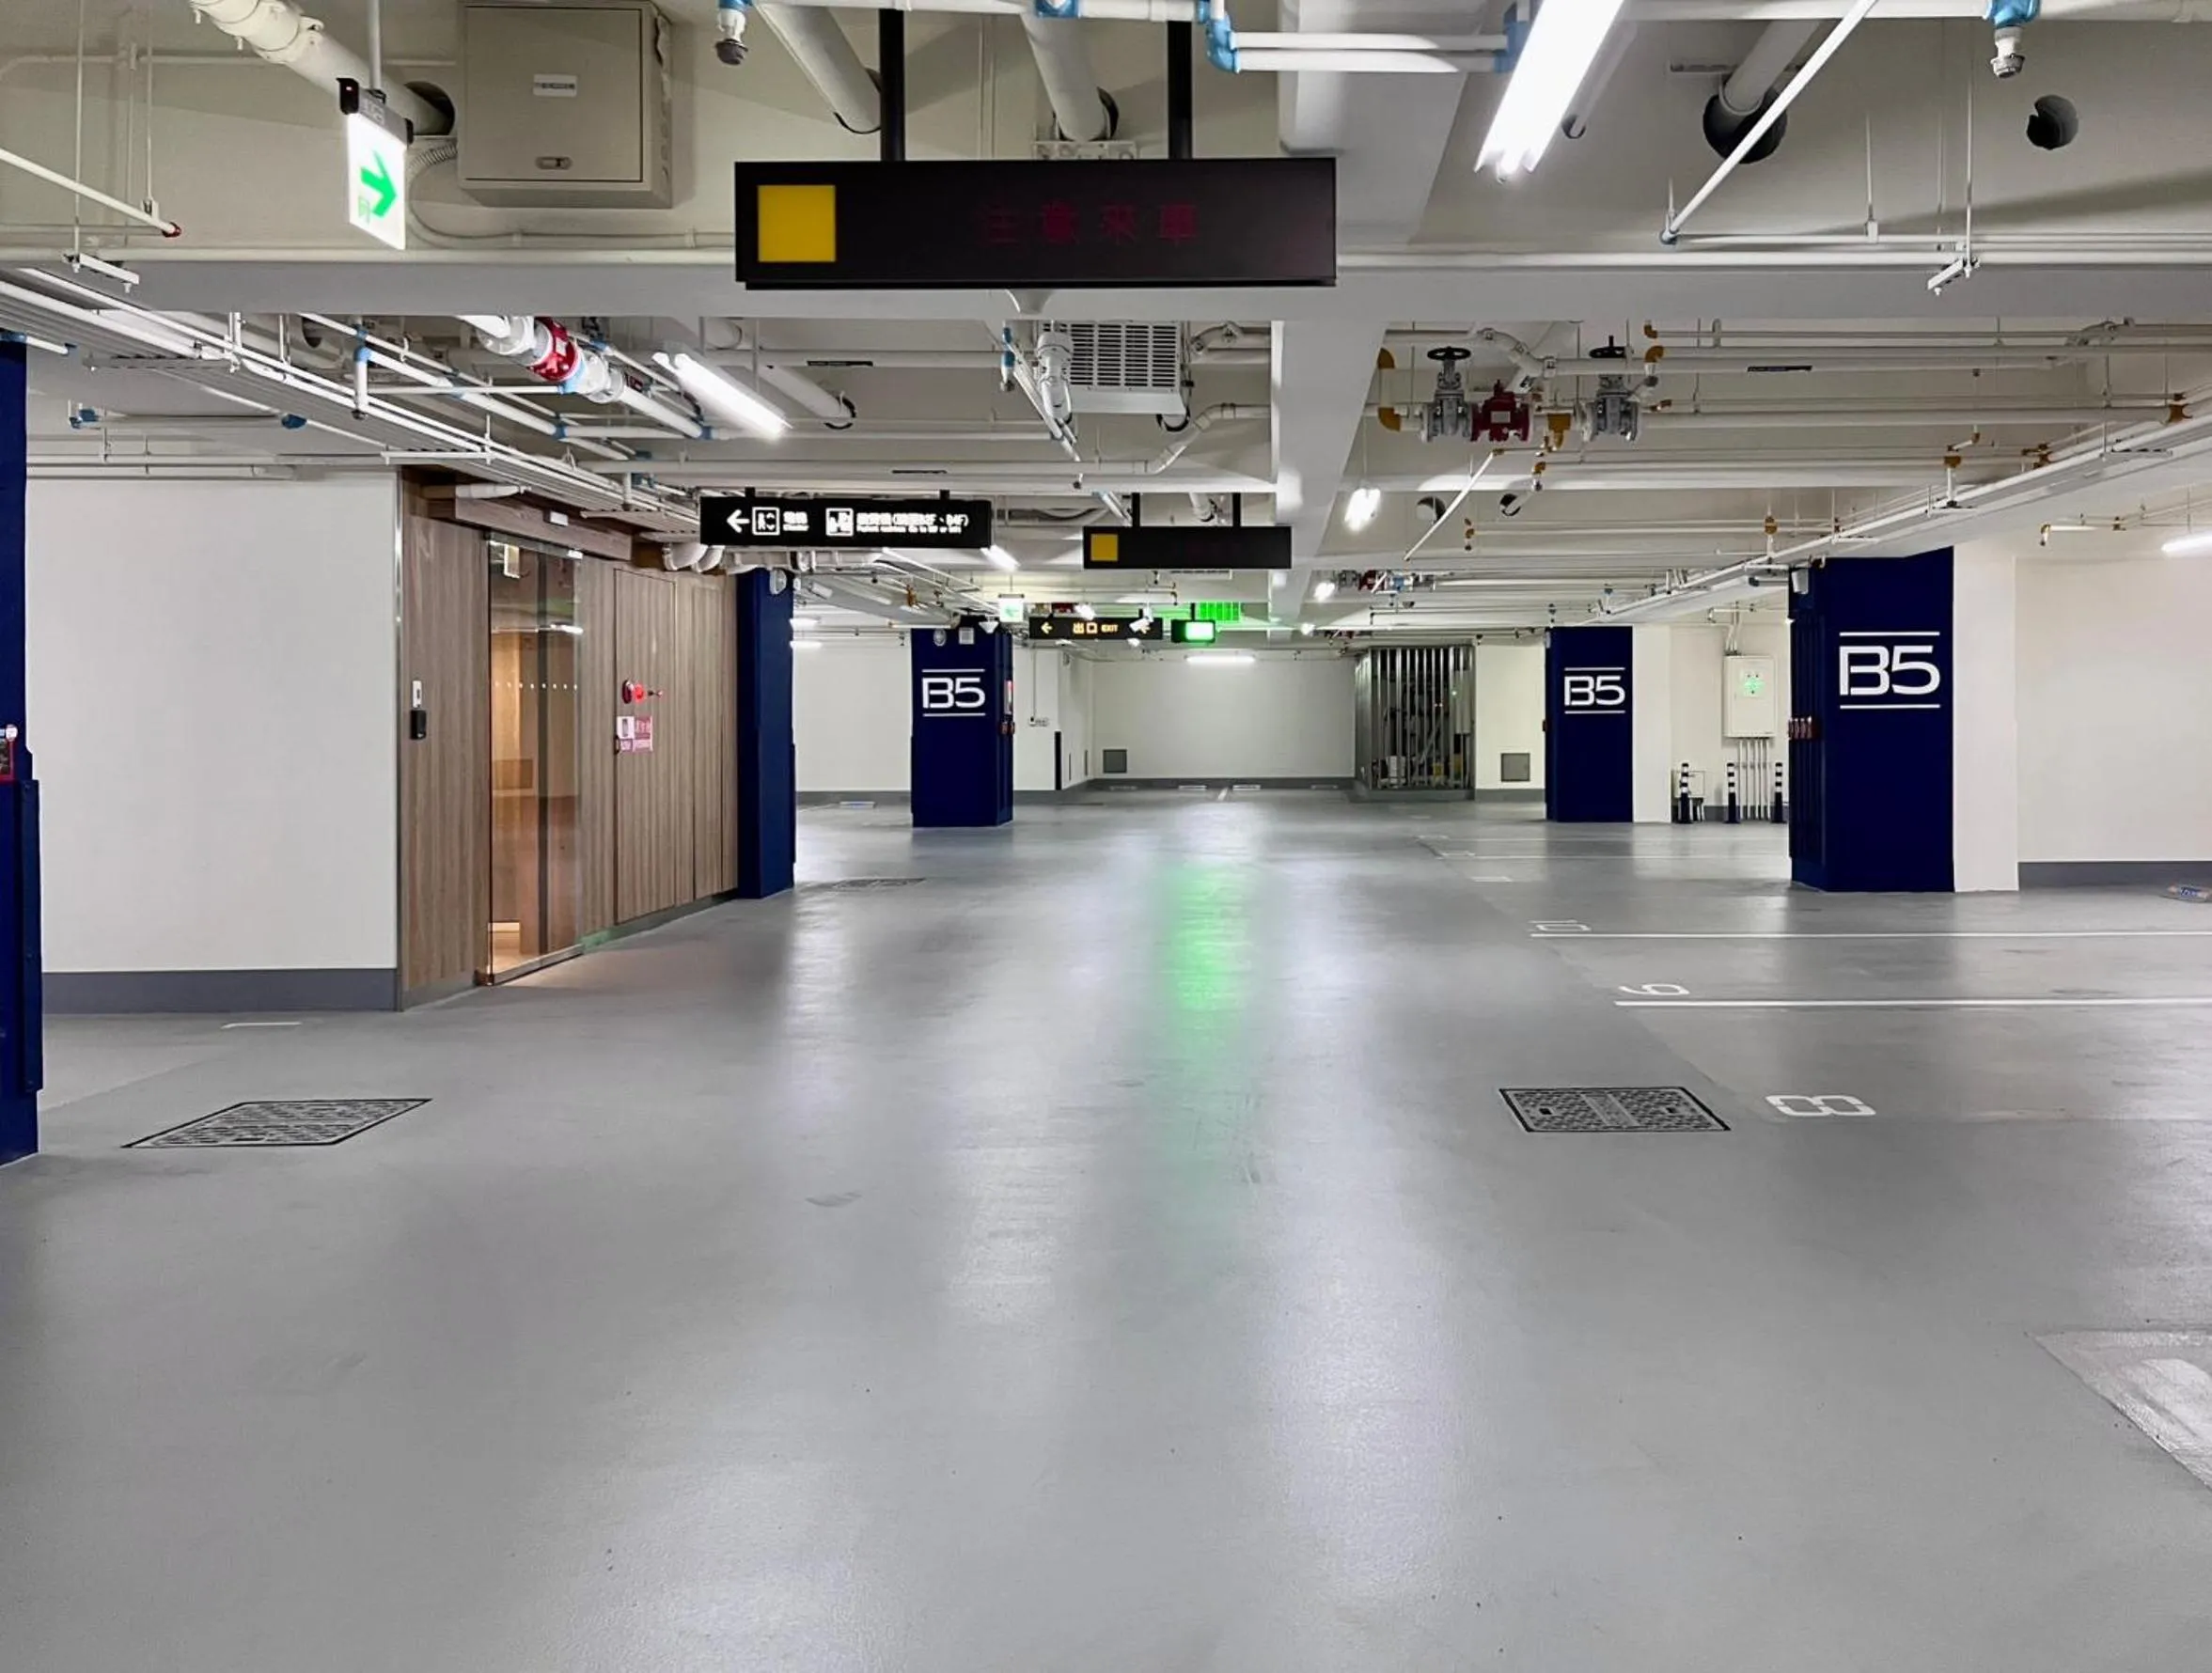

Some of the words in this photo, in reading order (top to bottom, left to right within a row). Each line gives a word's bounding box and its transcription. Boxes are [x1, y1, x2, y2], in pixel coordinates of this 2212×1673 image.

[1840, 645, 1940, 696] B5
[922, 677, 985, 709] B5
[1564, 676, 1625, 706] B5
[1765, 1095, 1876, 1117] 8
